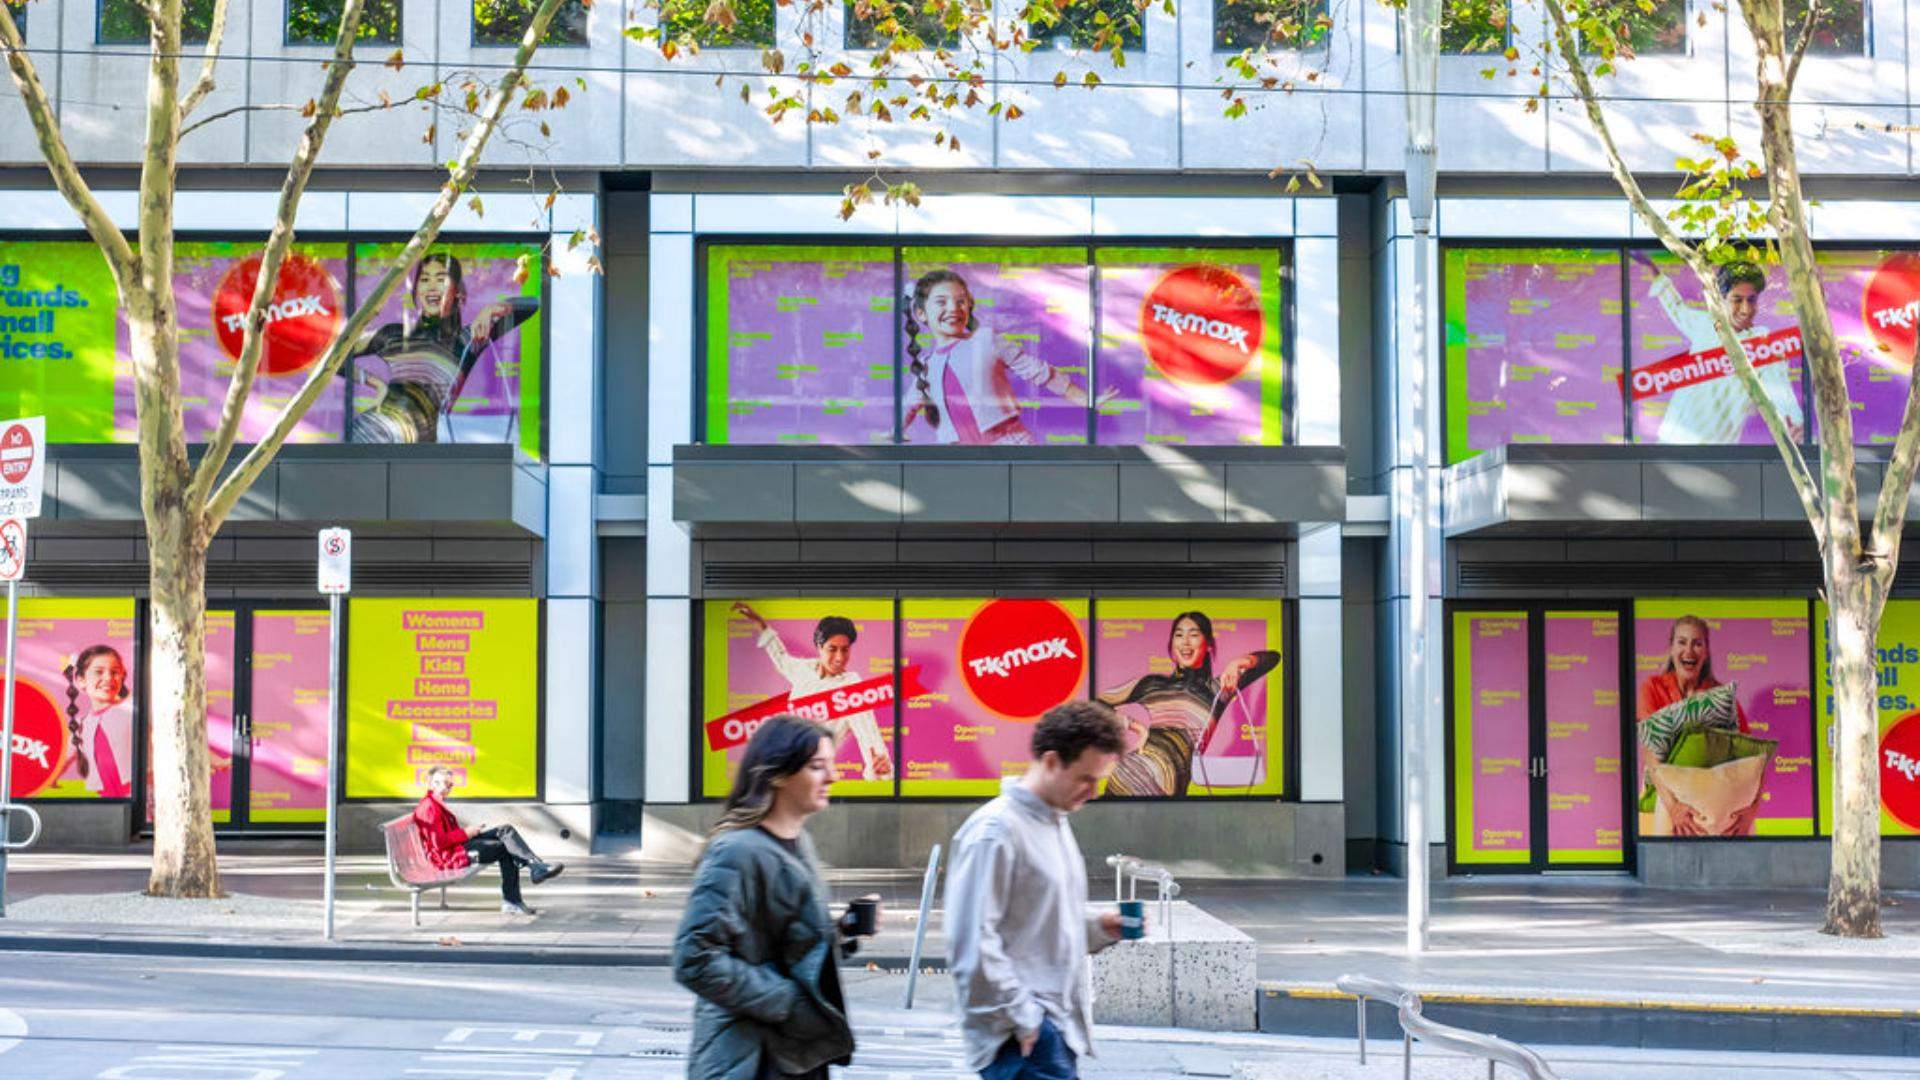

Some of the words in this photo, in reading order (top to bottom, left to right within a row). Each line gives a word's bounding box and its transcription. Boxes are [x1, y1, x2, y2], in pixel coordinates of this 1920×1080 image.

[1632, 355, 1736, 393] Opening
[1742, 336, 1800, 365] Soon
[406, 614, 480, 627] Womens
[420, 637, 466, 649] Mens
[424, 658, 461, 671] Kids
[418, 681, 466, 694] Home
[391, 703, 494, 716] Accessories
[723, 700, 829, 740] Oping
[831, 684, 895, 713] Soon
